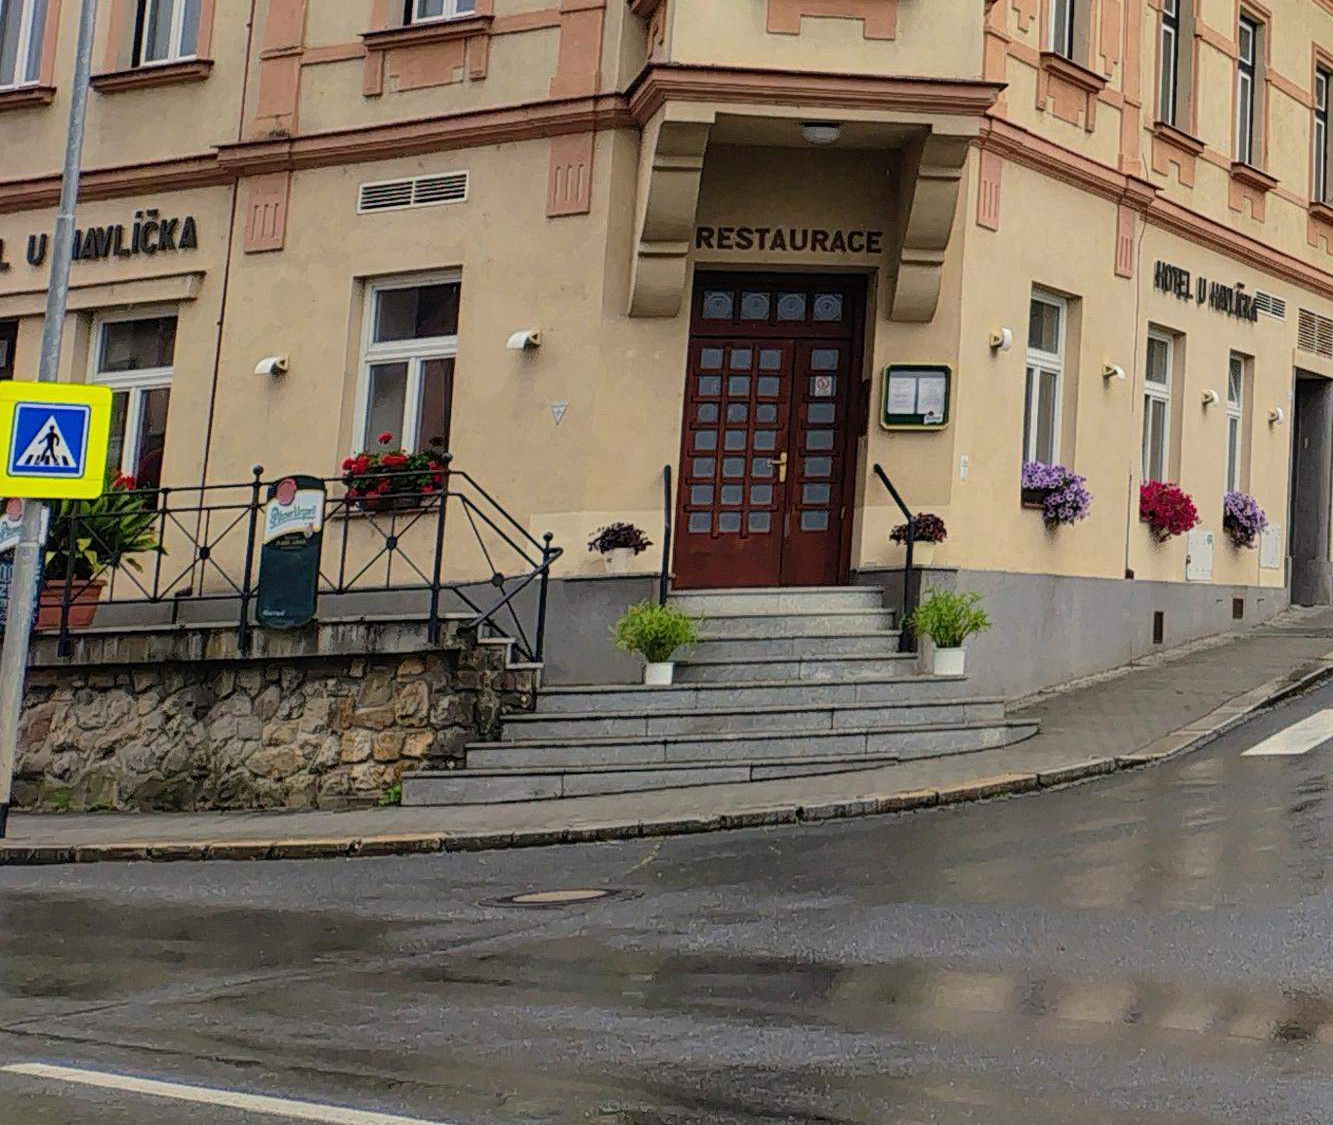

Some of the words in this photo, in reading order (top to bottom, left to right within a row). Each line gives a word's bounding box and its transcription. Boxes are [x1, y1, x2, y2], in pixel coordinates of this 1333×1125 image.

[27, 233, 48, 267] U
[695, 226, 883, 254] RESTAURACE
[1154, 260, 1194, 301] HOTEL
[1195, 276, 1207, 305] U
[1208, 281, 1258, 324] HAVLÍČKA
